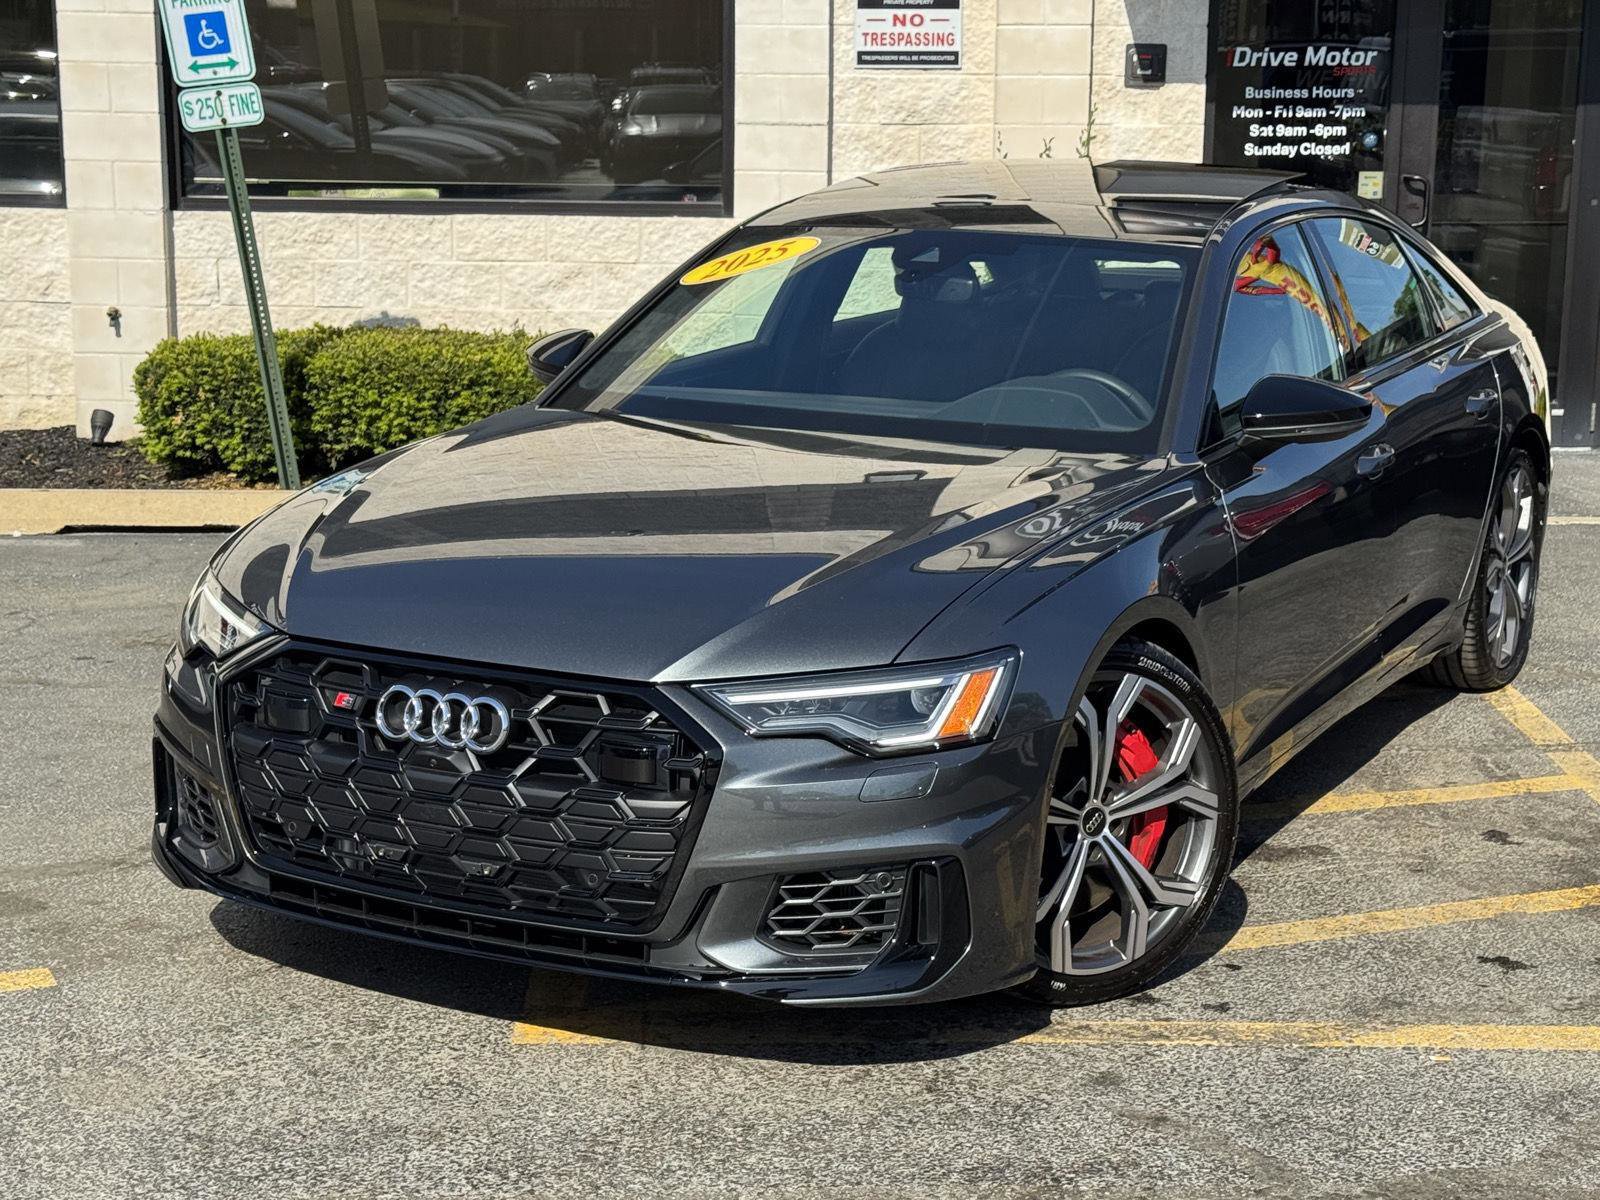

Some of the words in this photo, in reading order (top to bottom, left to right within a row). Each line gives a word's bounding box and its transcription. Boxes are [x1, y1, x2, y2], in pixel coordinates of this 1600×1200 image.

[892, 14, 925, 27] NO
[862, 32, 955, 46] TRESPASSING
[1304, 46, 1377, 67] Motor
[1245, 86, 1309, 99] Business
[1312, 86, 1355, 99] Hours
[228, 92, 259, 117] FINE
[1232, 105, 1264, 118] Mon
[1274, 105, 1293, 118] Fri
[1295, 105, 1327, 118] 9am
[1249, 124, 1274, 137] Sat
[1275, 124, 1307, 137] 9am
[1244, 142, 1298, 158] Sunday
[1299, 142, 1351, 156] Closed
[701, 240, 796, 280] 2025
